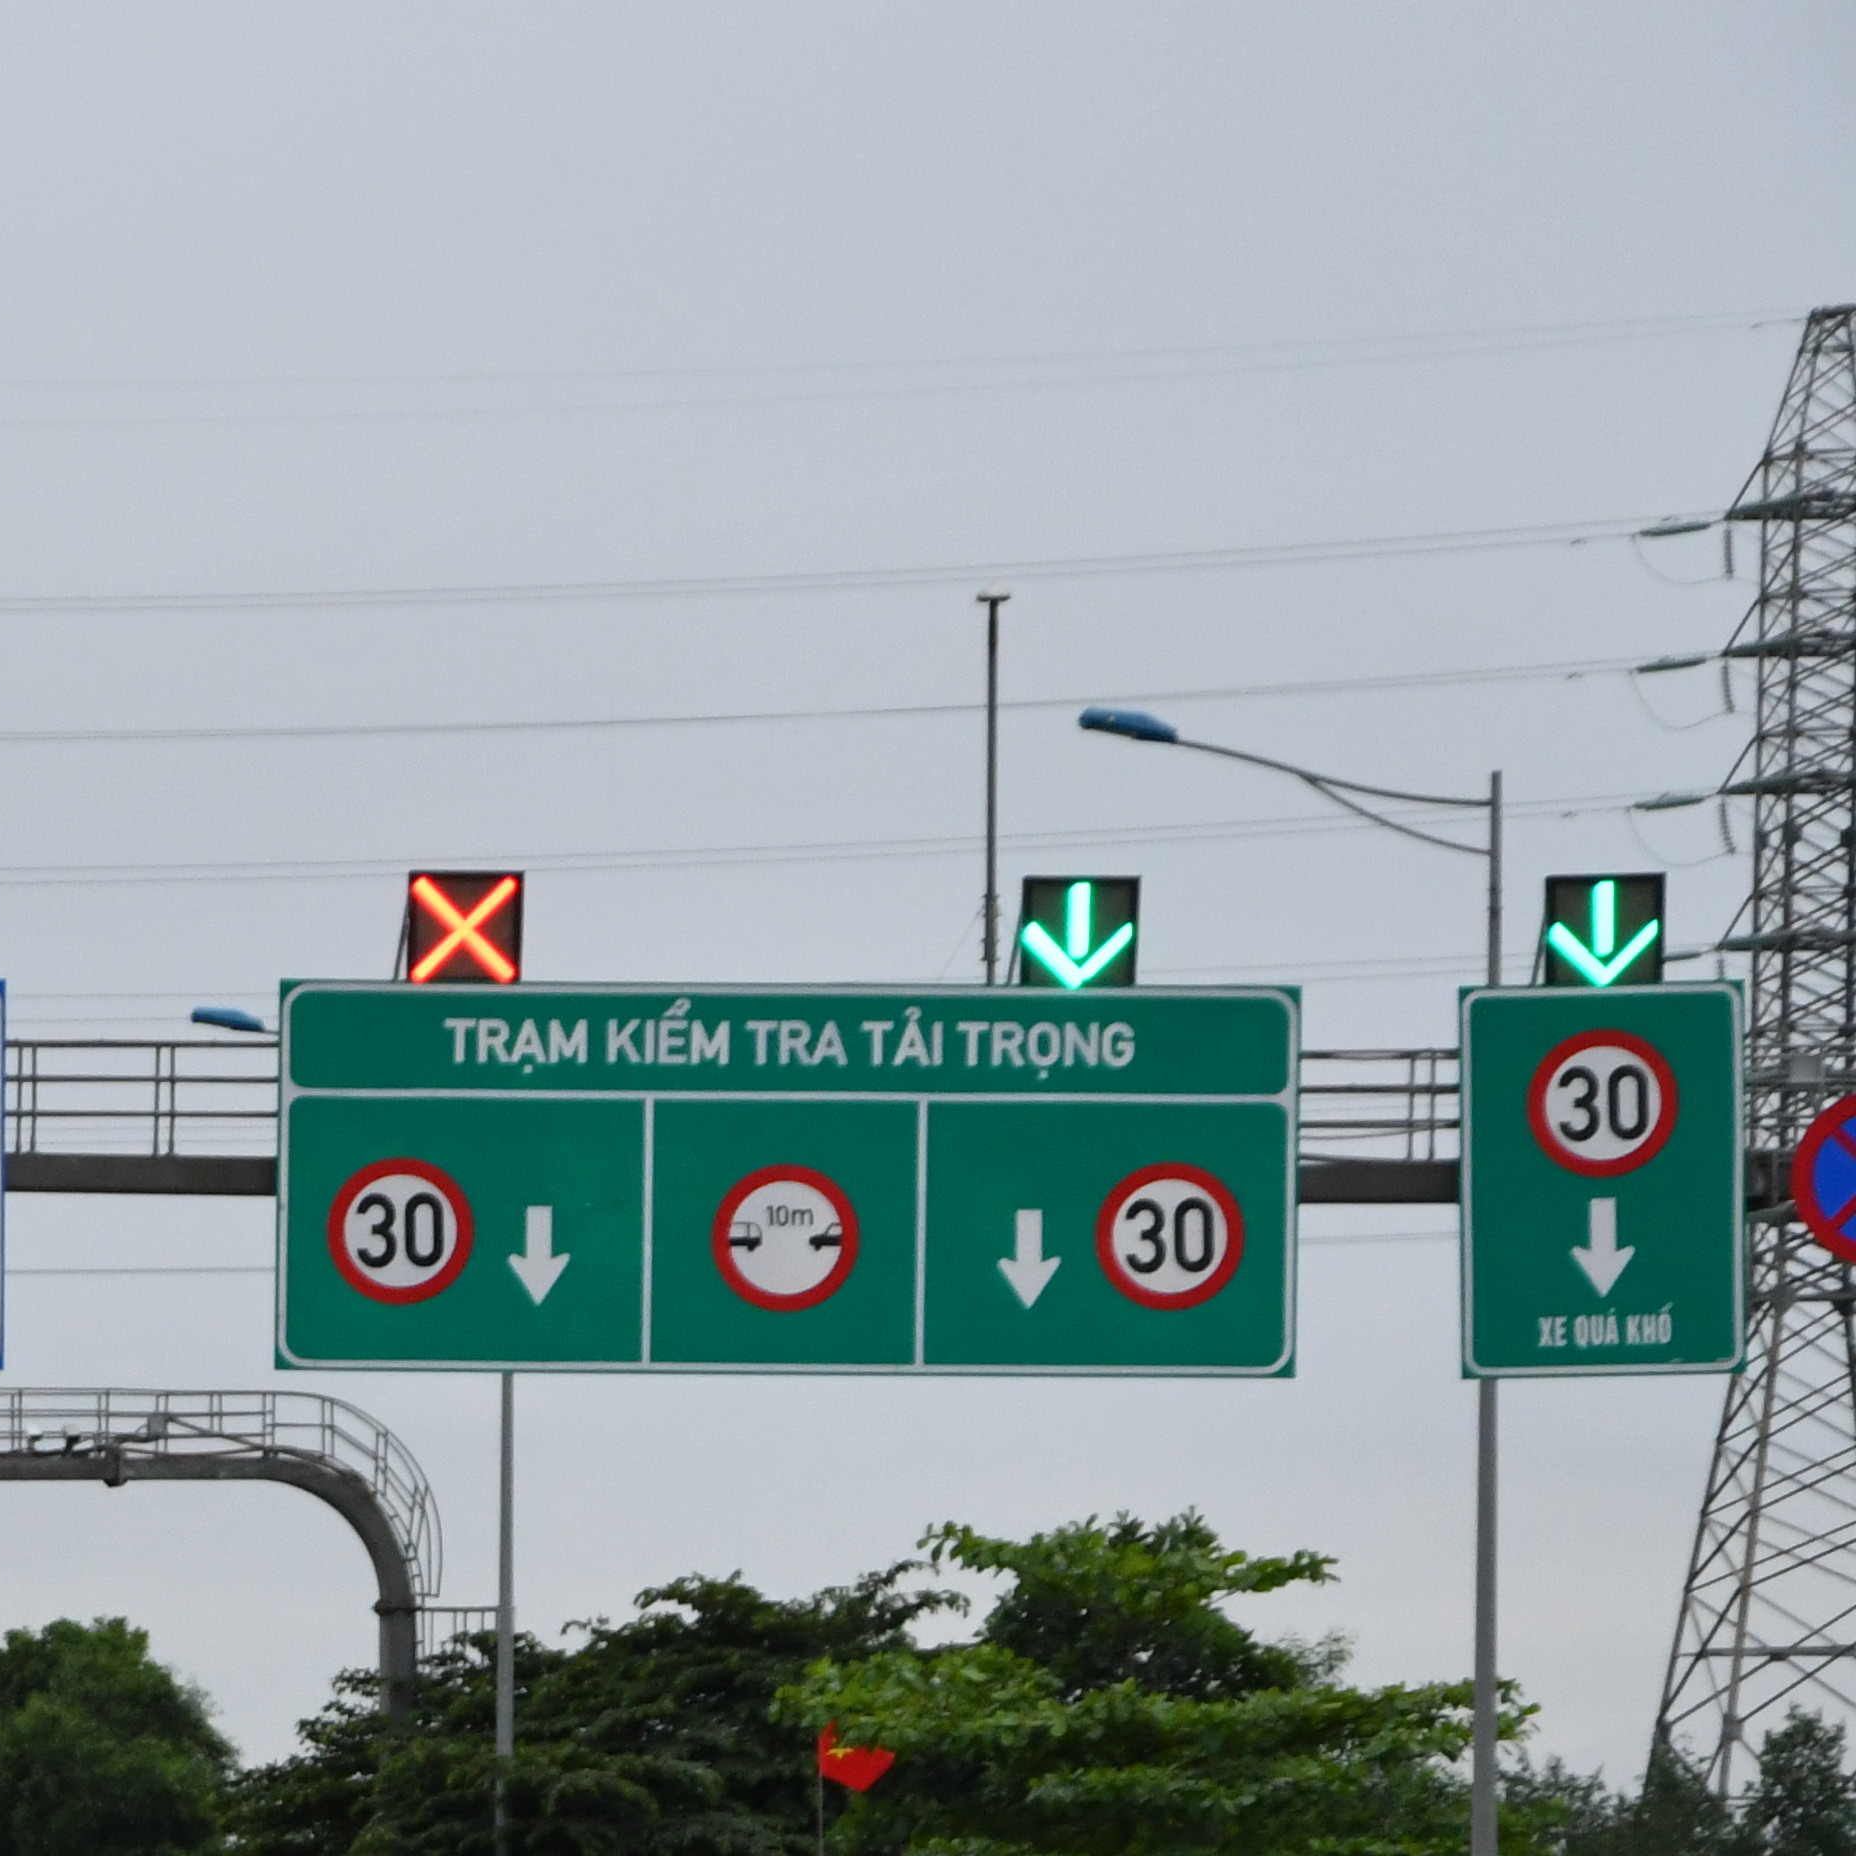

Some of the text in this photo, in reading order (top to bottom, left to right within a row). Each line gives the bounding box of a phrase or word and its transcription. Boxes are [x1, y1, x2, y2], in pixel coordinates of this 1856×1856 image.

[443, 997, 1136, 1080] TRẠM KIỂM TRA TẢI TRỌNG
[1558, 1064, 1649, 1142] 30
[356, 1192, 445, 1268] 30
[766, 1205, 815, 1227] 10m
[1125, 1197, 1214, 1273] 30
[1538, 1316, 1567, 1347] XE
[1573, 1307, 1619, 1348] QUÁ
